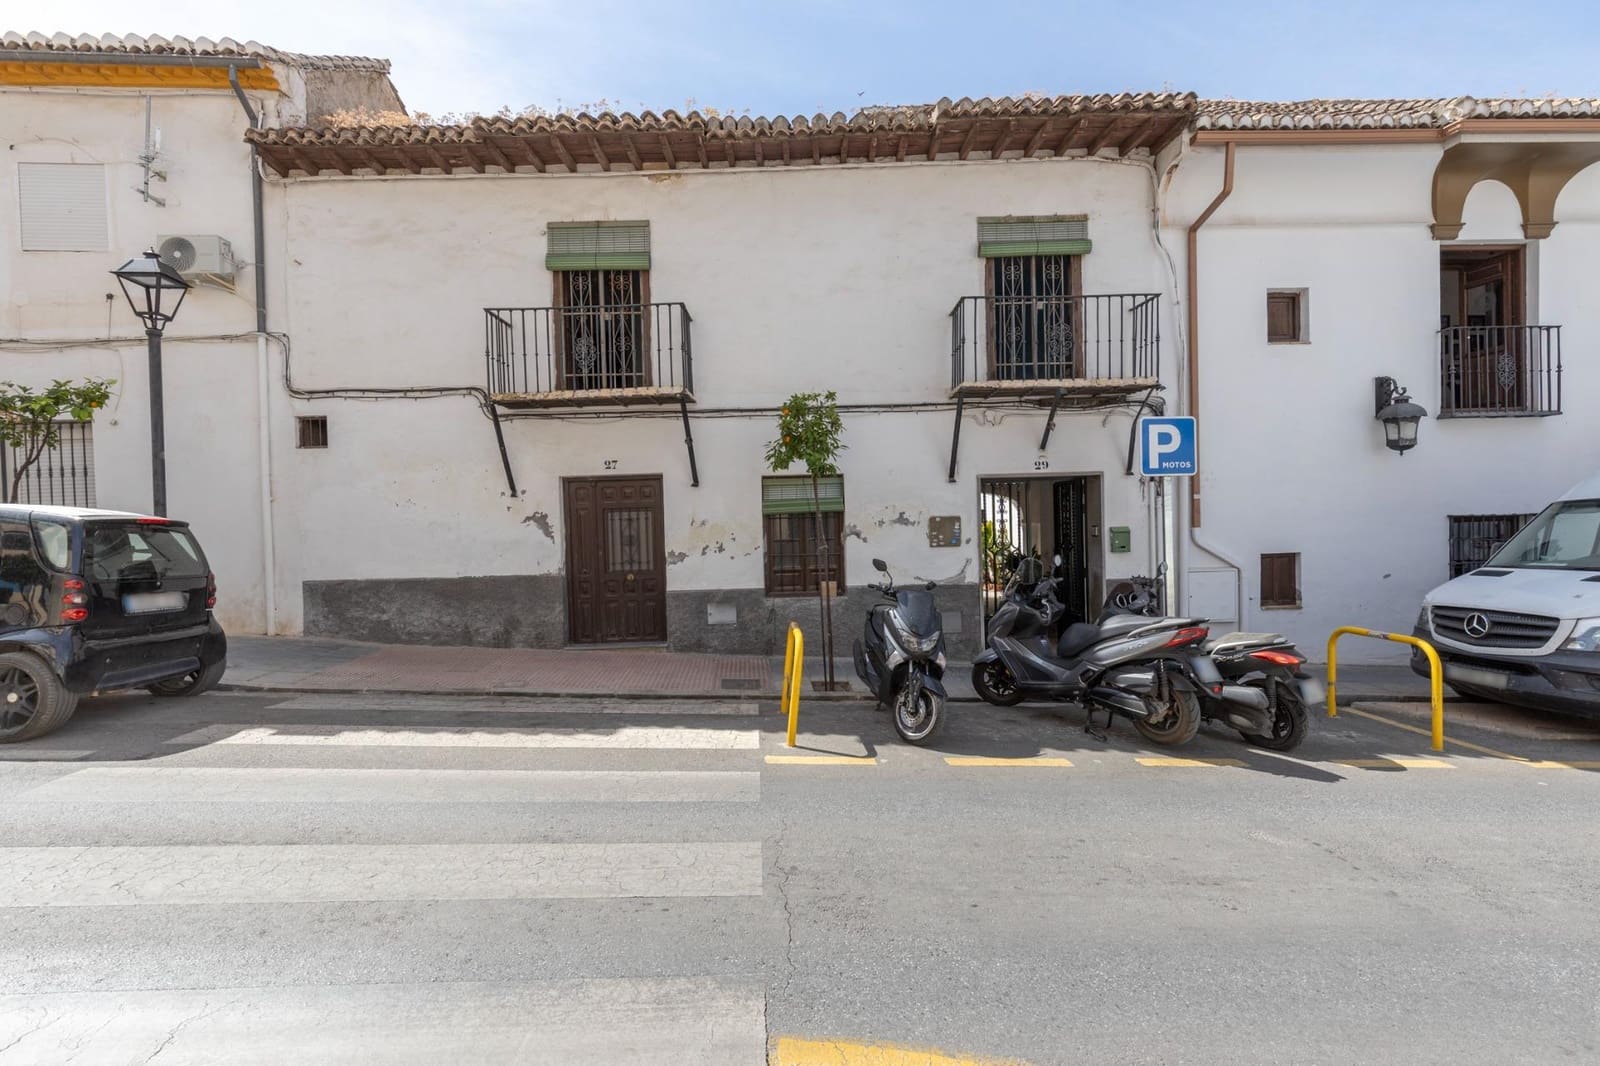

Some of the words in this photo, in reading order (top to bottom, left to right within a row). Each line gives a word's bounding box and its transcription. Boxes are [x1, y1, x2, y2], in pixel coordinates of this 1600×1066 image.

[1149, 424, 1181, 469] P
[604, 460, 618, 469] 27
[1034, 461, 1049, 470] 29
[1162, 461, 1192, 469] MOTOS
